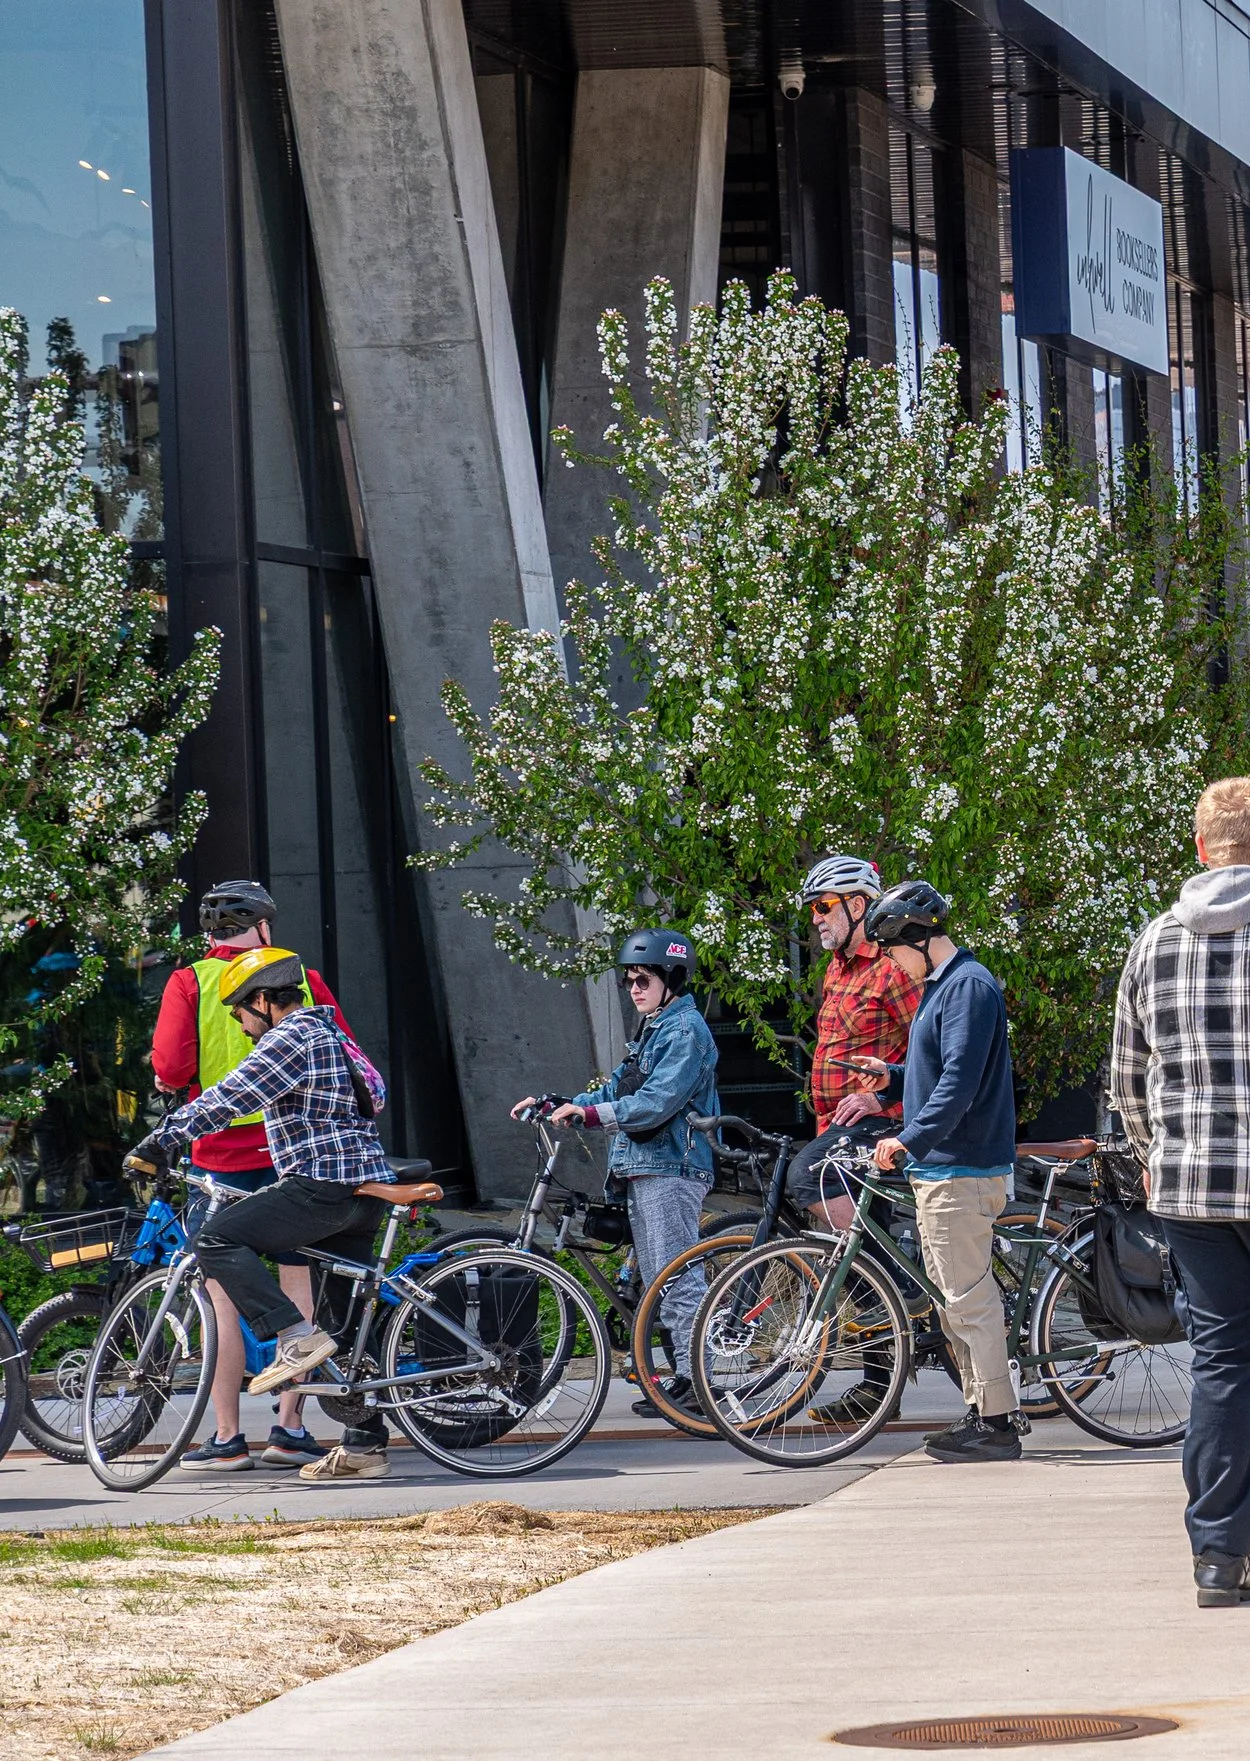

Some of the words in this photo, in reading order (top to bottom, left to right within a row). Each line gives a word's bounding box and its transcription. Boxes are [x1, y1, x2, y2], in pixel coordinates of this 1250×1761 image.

[1115, 227, 1159, 283] BOOKSELLERS
[1121, 278, 1156, 327] COMPANY
[667, 943, 687, 955] ACE
